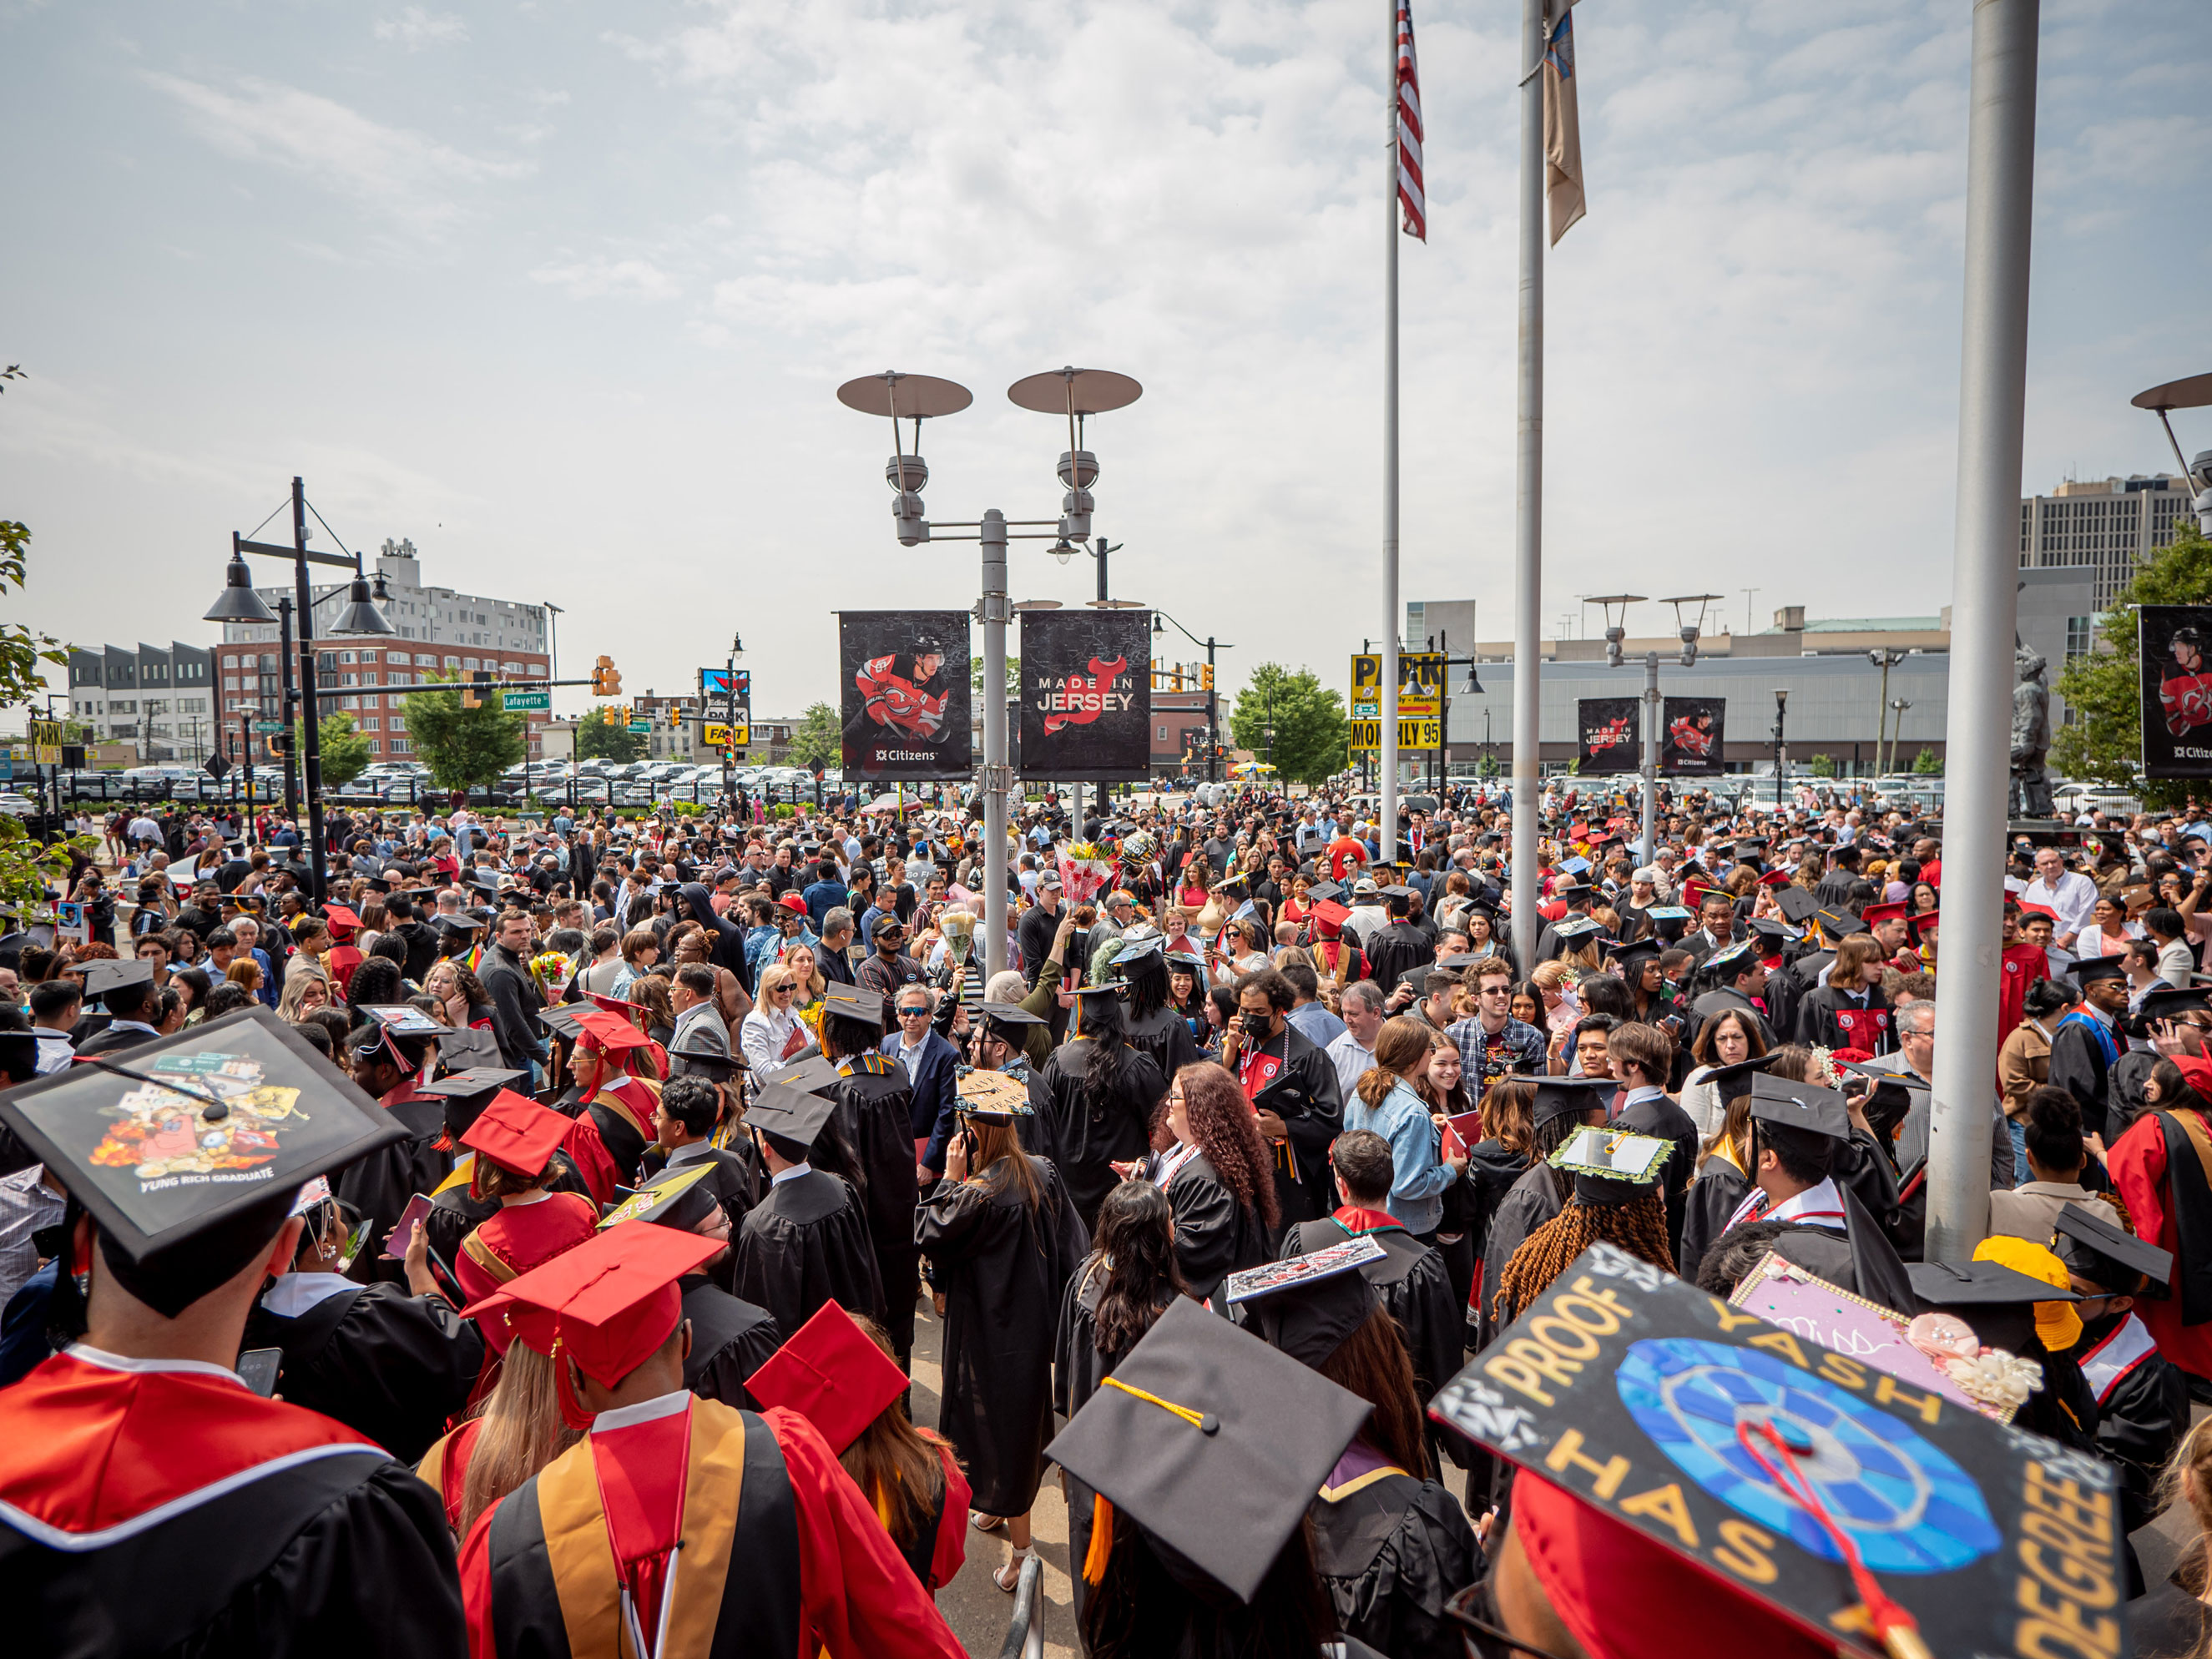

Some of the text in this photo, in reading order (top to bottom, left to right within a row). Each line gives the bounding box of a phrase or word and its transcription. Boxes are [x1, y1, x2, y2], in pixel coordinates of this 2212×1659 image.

[1356, 656, 1442, 686] PRK
[1038, 678, 1133, 689] MADE IN
[505, 696, 542, 708] Lafayette
[1037, 693, 1134, 712] JERSEY
[709, 712, 745, 723] PAK
[33, 722, 61, 746] PARK
[710, 729, 745, 739] FAT
[1585, 734, 1632, 744] JERSEY
[1586, 727, 1615, 735] MADE
[888, 749, 936, 761] Citizens
[2185, 746, 2212, 759] Citize
[968, 1075, 997, 1092] SAVE
[988, 1092, 1026, 1111] TEARS
[140, 1167, 275, 1193] YUNG RICH GRADUATE
[1483, 1274, 1634, 1408] PROOF
[1708, 1296, 1943, 1425] YASH
[1545, 1419, 1780, 1585] HAS
